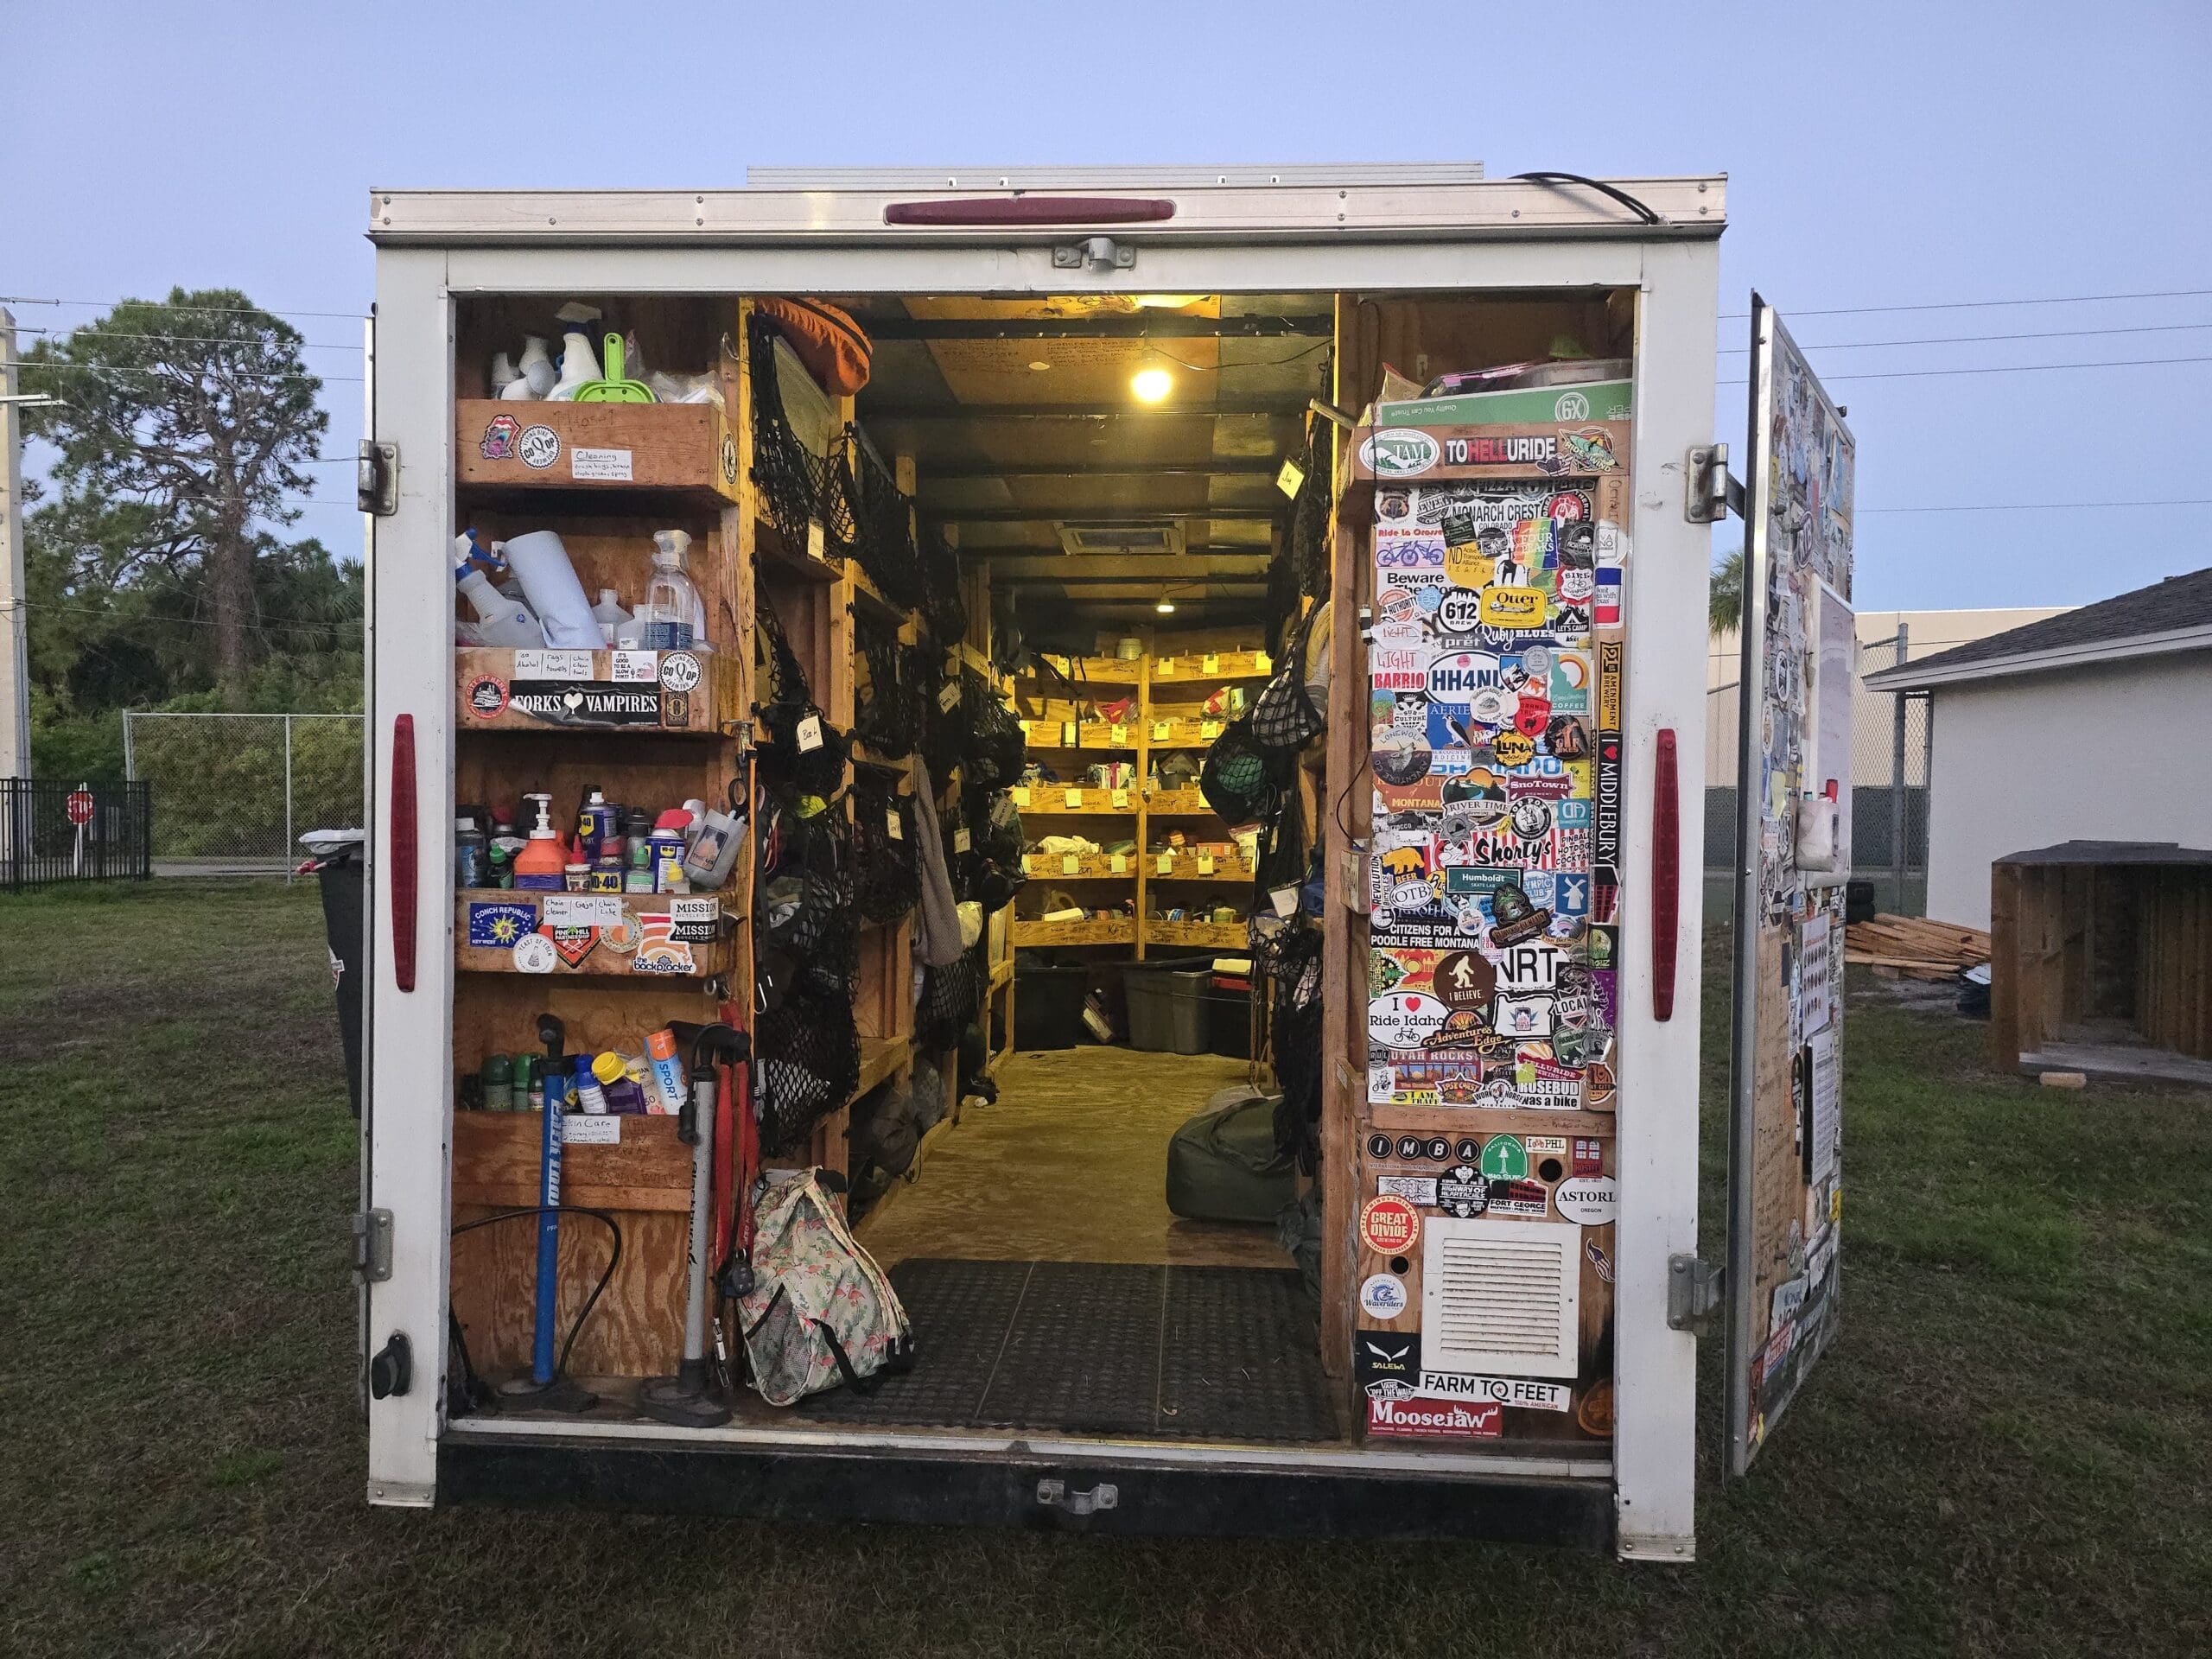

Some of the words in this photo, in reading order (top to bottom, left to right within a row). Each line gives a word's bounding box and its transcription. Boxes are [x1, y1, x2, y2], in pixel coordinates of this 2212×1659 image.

[524, 448, 535, 459] CO
[544, 437, 555, 449] OP
[1394, 444, 1425, 460] TAM
[1565, 442, 1585, 457] RIDE
[575, 451, 617, 461] Cleaning
[1590, 456, 1611, 473] WIND
[1452, 505, 1504, 523] MONARCH
[1507, 503, 1541, 520] CREST
[1522, 532, 1554, 543] FOUR
[1522, 542, 1554, 553] PEAKS
[1449, 547, 1463, 565] ND
[1387, 573, 1445, 583] Beware
[1395, 585, 1422, 595] The
[1497, 592, 1539, 603] Otter
[1389, 597, 1418, 614] AUTHORITY
[1446, 601, 1478, 620] 612
[1572, 624, 1589, 632] CAMP
[1474, 625, 1516, 652] Ruby
[1516, 629, 1555, 639] BLUES
[547, 654, 563, 663] rags
[1376, 649, 1417, 670] LIGHT
[663, 666, 674, 677] CO
[686, 671, 697, 682] OP
[1374, 672, 1425, 690] BARRIO
[586, 695, 658, 713] VAMPIRES
[1609, 675, 1618, 726] AMENDMENT
[1430, 705, 1471, 715] AERIE
[1380, 728, 1424, 744] LONEWOLF
[1496, 740, 1532, 755] LUNA
[1510, 780, 1569, 790] SnoTown
[1392, 798, 1442, 808] MONTANA
[1450, 801, 1481, 813] RIVER
[1484, 800, 1509, 811] TIME
[1599, 763, 1618, 865] MIDDLEBURY
[1476, 837, 1552, 865] Shorty's
[591, 875, 619, 889] D-40
[1395, 874, 1417, 882] BEER
[1462, 874, 1505, 882] Humboldt
[1395, 887, 1428, 903] OTB
[474, 907, 498, 919] CONCH
[499, 907, 531, 921] REPUBLIC
[1389, 925, 1432, 936] CITIZENS
[1433, 926, 1452, 936] FOR
[1453, 926, 1461, 936] A
[518, 939, 534, 951] YEAST
[1370, 935, 1408, 946] POODLE
[1409, 937, 1433, 947] FREE
[1434, 938, 1480, 949] MONTANA
[634, 961, 693, 973] backpacker
[1449, 992, 1452, 1001] I
[1454, 990, 1482, 1001] BELIEVE
[1393, 997, 1399, 1011] I
[1370, 1015, 1400, 1026] Ride
[1404, 1015, 1444, 1026] Idaho
[1473, 1033, 1503, 1054] Edge
[1390, 1051, 1425, 1060] UTAH
[1430, 1051, 1474, 1061] ROCKS
[659, 1063, 679, 1101] SPORT
[1519, 1082, 1580, 1096] ROSEBUD
[1474, 1091, 1493, 1101] WORK
[1544, 1097, 1551, 1106] a
[1554, 1095, 1578, 1107] bike
[1528, 1138, 1531, 1147] I
[1545, 1139, 1565, 1149] PHL
[1514, 1201, 1547, 1210] GEORGE
[1371, 1211, 1408, 1225] GREAT
[1370, 1224, 1408, 1238] DIVIDE
[1363, 1299, 1403, 1307] Waveriders
[1371, 1362, 1406, 1370] SALEWA
[1425, 1374, 1474, 1394] FARM
[1480, 1380, 1509, 1401] TO
[1514, 1382, 1560, 1402] FEET
[1530, 1401, 1559, 1409] AMERICAN
[1371, 1400, 1498, 1428] Moosejaw
